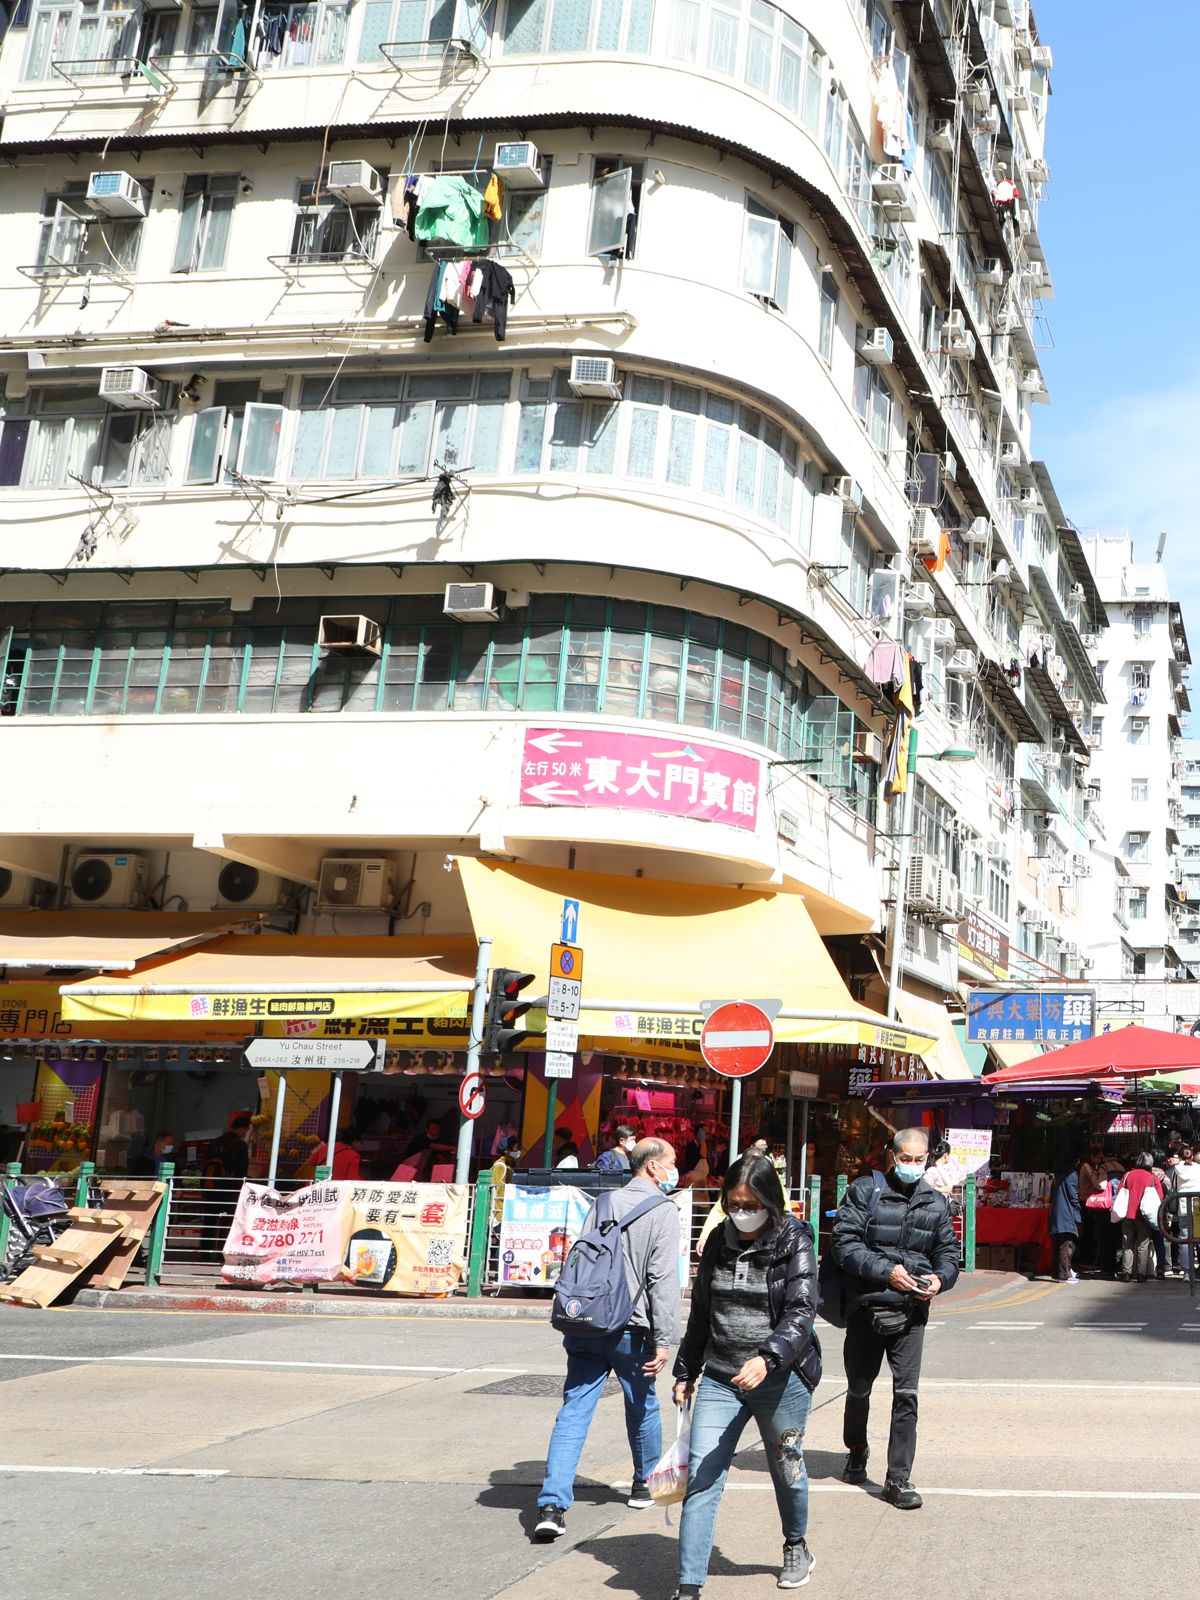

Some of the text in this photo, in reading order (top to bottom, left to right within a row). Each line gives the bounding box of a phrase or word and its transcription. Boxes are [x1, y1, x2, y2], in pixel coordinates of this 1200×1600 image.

[583, 756, 757, 816] 東大門賓館
[562, 984, 579, 996] 8-10
[1, 1000, 28, 1008] STORE
[212, 998, 267, 1017] 鮮漁生
[270, 1001, 332, 1012] 豬肉鮮魚專門店
[560, 1002, 575, 1013] 5-7
[970, 995, 1092, 1026] 中興大藥坊 藥
[0, 1009, 73, 1034] 專門店
[637, 1016, 691, 1035] 鮮漁生
[977, 1028, 1082, 1040] 政府註冊 正版正貨
[279, 1042, 342, 1050] Yu Chau Street
[291, 1055, 326, 1065] 汝州街
[351, 1187, 419, 1204] 預防愛滋
[366, 1203, 446, 1225] 要有一套
[258, 1233, 295, 1248] 2780
